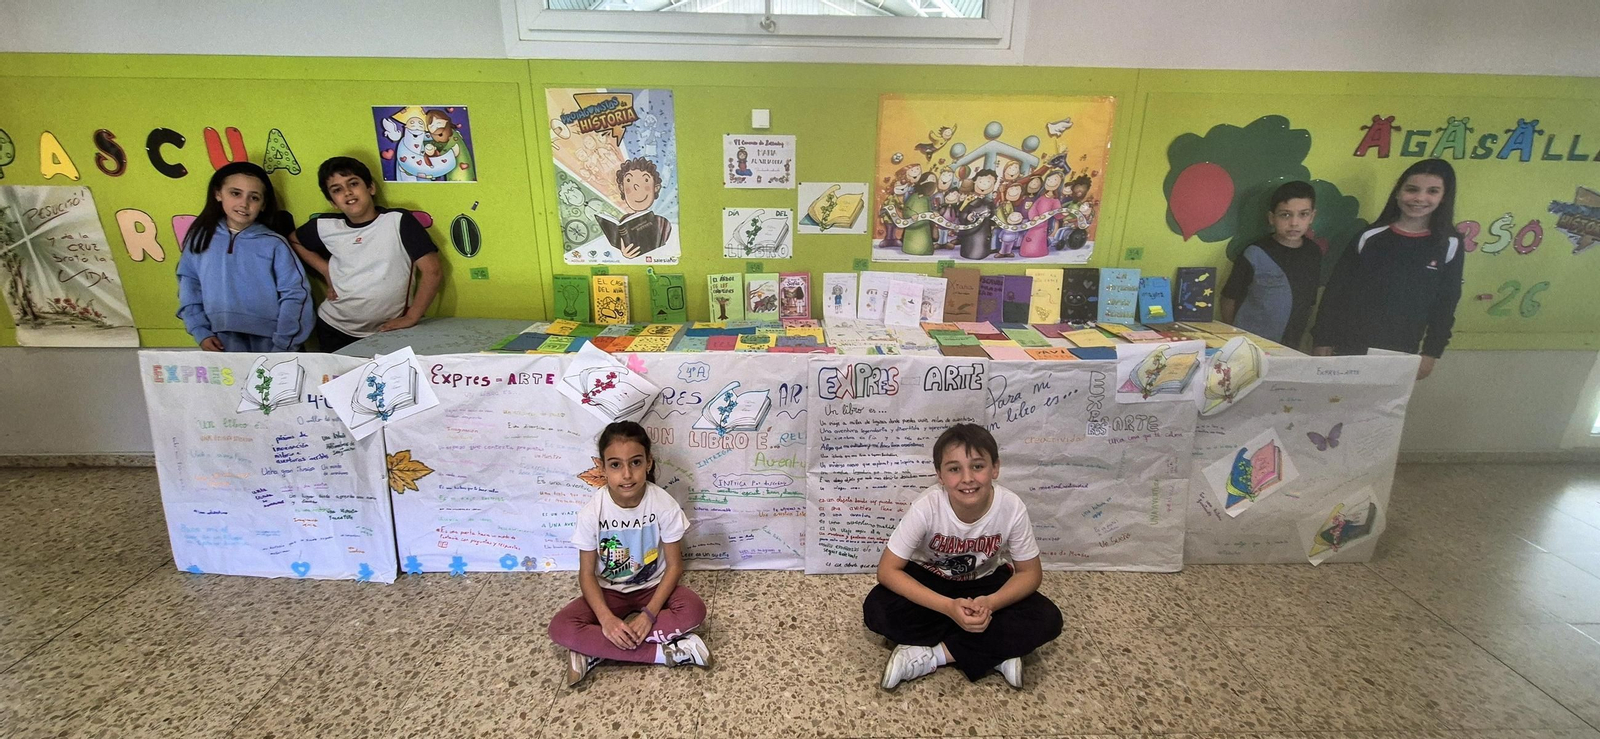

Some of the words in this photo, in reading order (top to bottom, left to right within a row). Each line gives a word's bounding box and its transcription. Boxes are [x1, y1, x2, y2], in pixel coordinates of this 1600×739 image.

[580, 109, 638, 133] HISTORIA
[1353, 115, 1600, 162] AGASALL
[67, 243, 100, 252] CRUZ
[94, 254, 107, 263] la
[152, 364, 235, 386] EXPRES
[430, 363, 491, 388] Expres
[507, 372, 555, 386] ARTE
[818, 362, 900, 400] EXPRES
[923, 363, 985, 392] ARTE
[985, 374, 1022, 419] Para
[824, 404, 839, 416] Un
[842, 403, 865, 416] libro
[1006, 401, 1036, 423] libro
[1112, 414, 1160, 433] ARTE
[689, 430, 749, 450] LIBRO
[599, 513, 656, 530] MONACO
[929, 532, 1002, 558] CHAMPIONS
